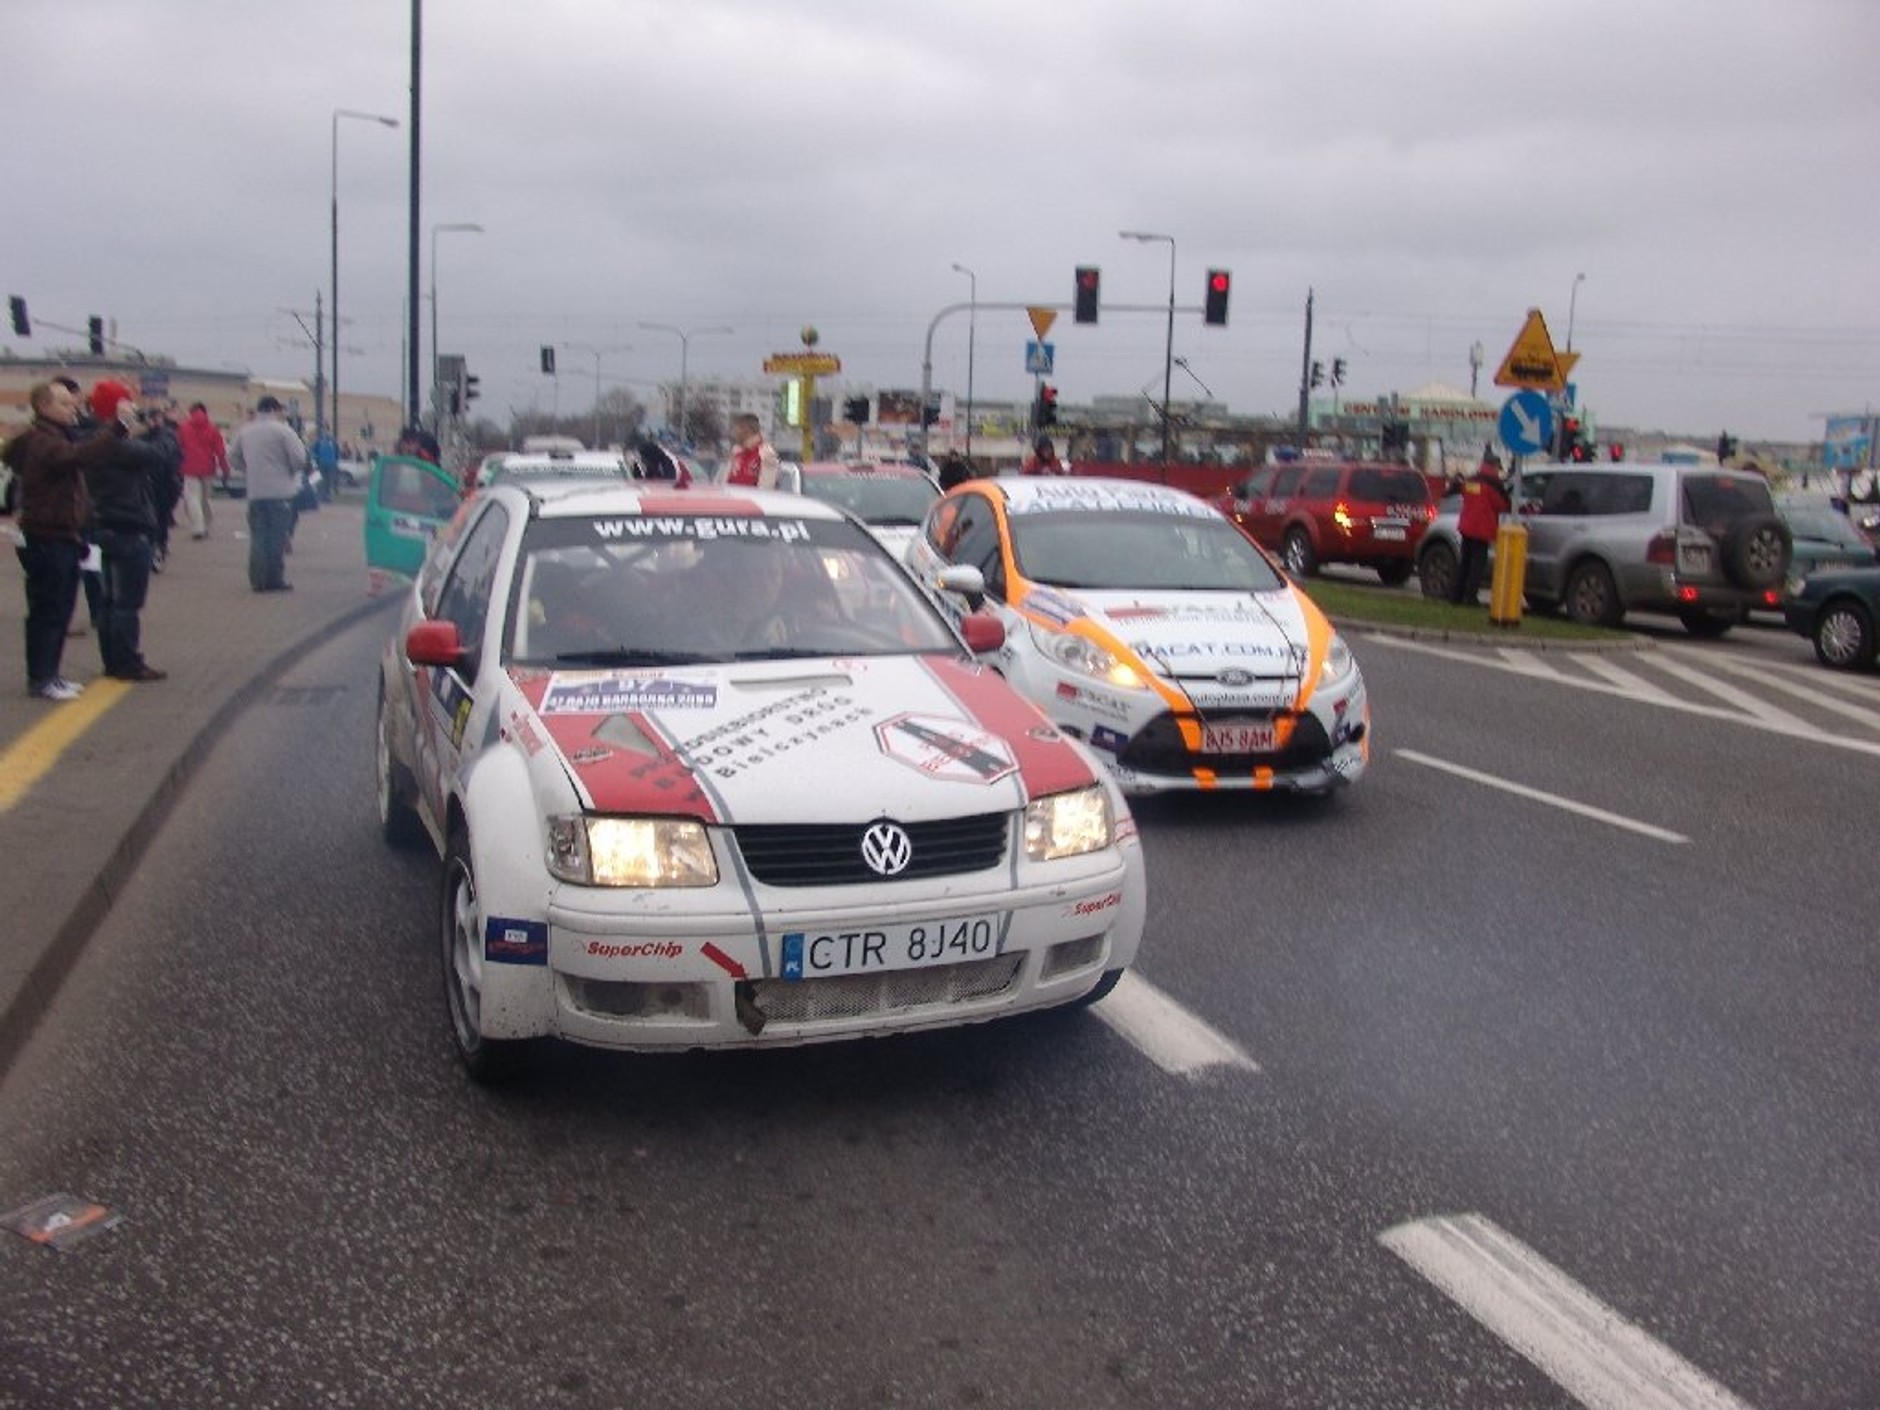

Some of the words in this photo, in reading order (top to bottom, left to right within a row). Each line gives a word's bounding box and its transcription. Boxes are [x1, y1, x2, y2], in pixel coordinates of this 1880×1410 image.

[1343, 403, 1411, 417] CENTM
[593, 517, 810, 543] www.gura.pl
[587, 941, 682, 959] SuperChip
[810, 931, 887, 970] CTR
[908, 919, 991, 961] 8J40
